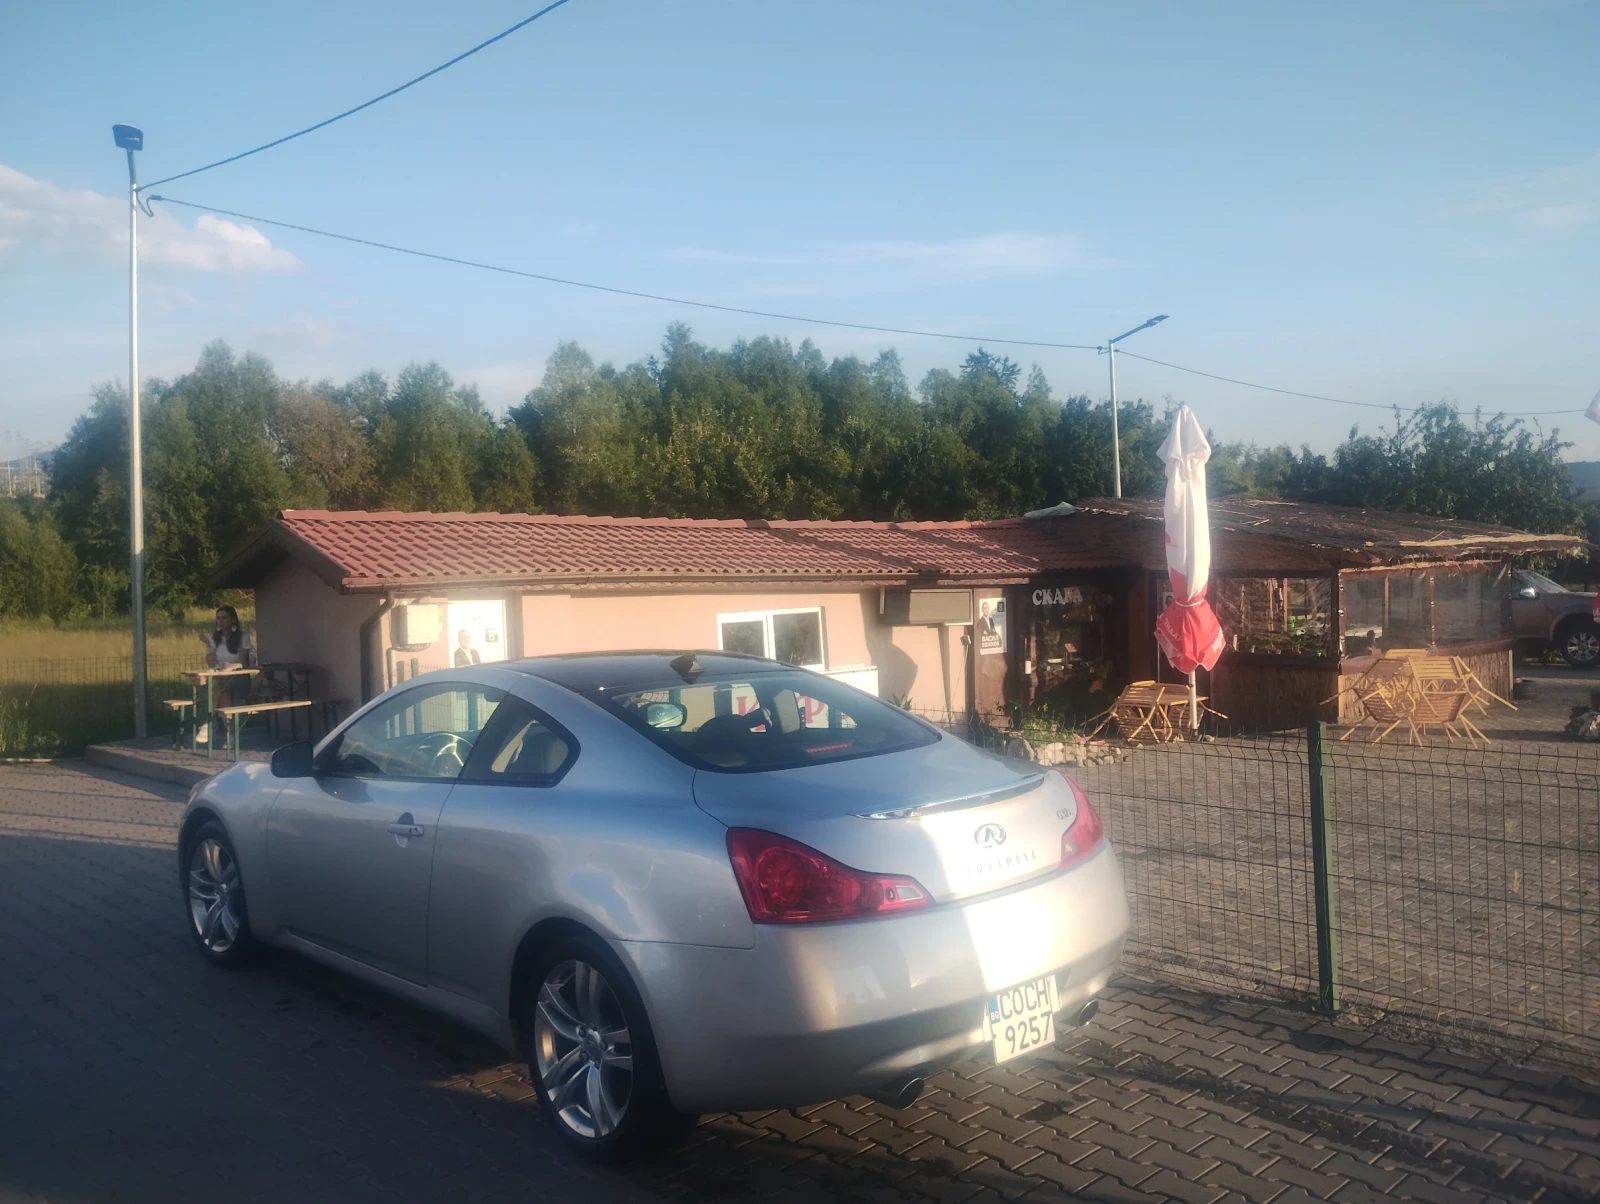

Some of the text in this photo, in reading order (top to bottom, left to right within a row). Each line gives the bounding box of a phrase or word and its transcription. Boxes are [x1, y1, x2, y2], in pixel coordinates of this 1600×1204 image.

[990, 1011, 999, 1021] BG
[999, 977, 1049, 1020] COCH
[1005, 1010, 1052, 1054] 9257
